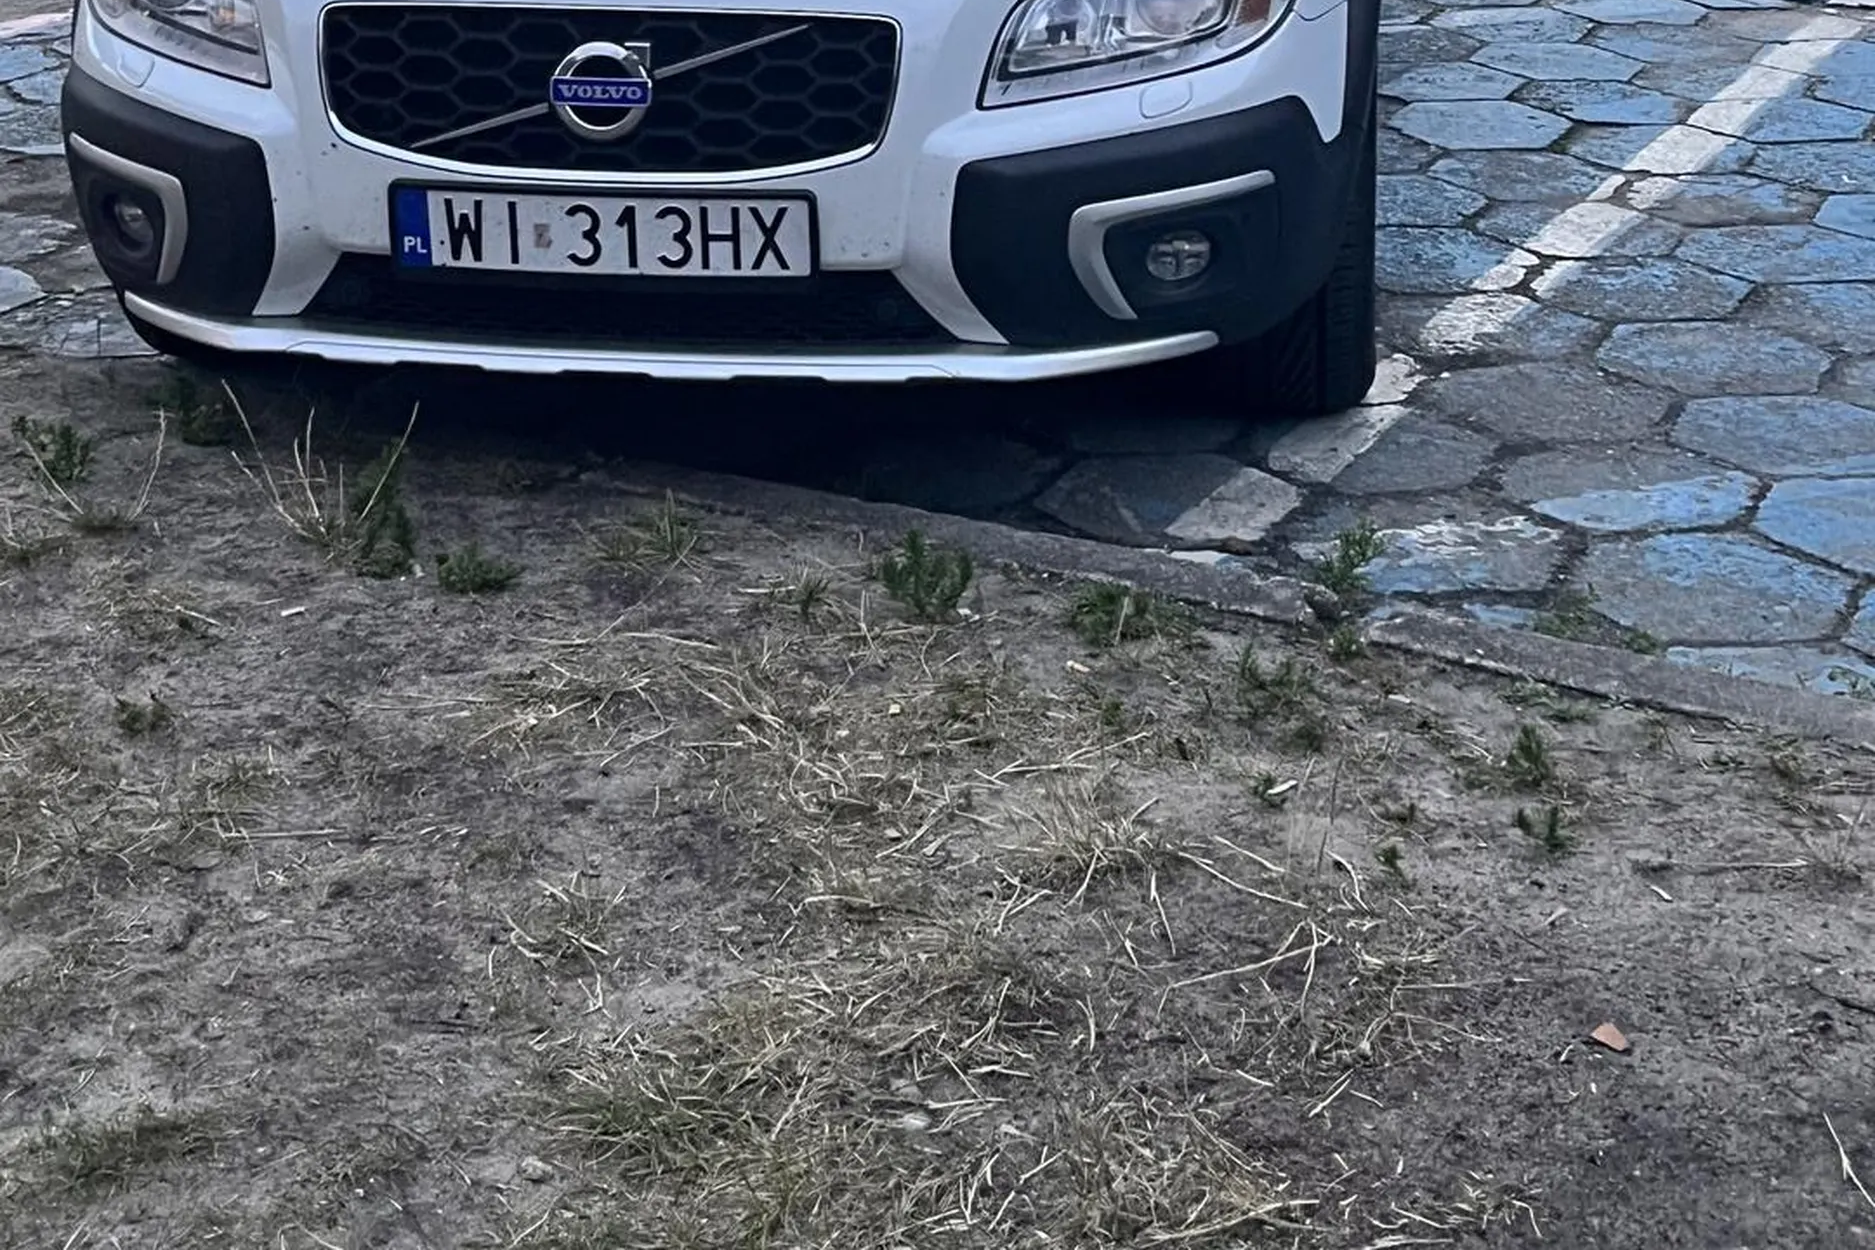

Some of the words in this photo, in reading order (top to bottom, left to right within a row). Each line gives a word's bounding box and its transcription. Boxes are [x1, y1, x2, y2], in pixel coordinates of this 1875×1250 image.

[557, 84, 643, 100] VOLVO
[444, 197, 519, 264] WI
[565, 203, 790, 270] 313HX
[403, 236, 427, 253] PL
